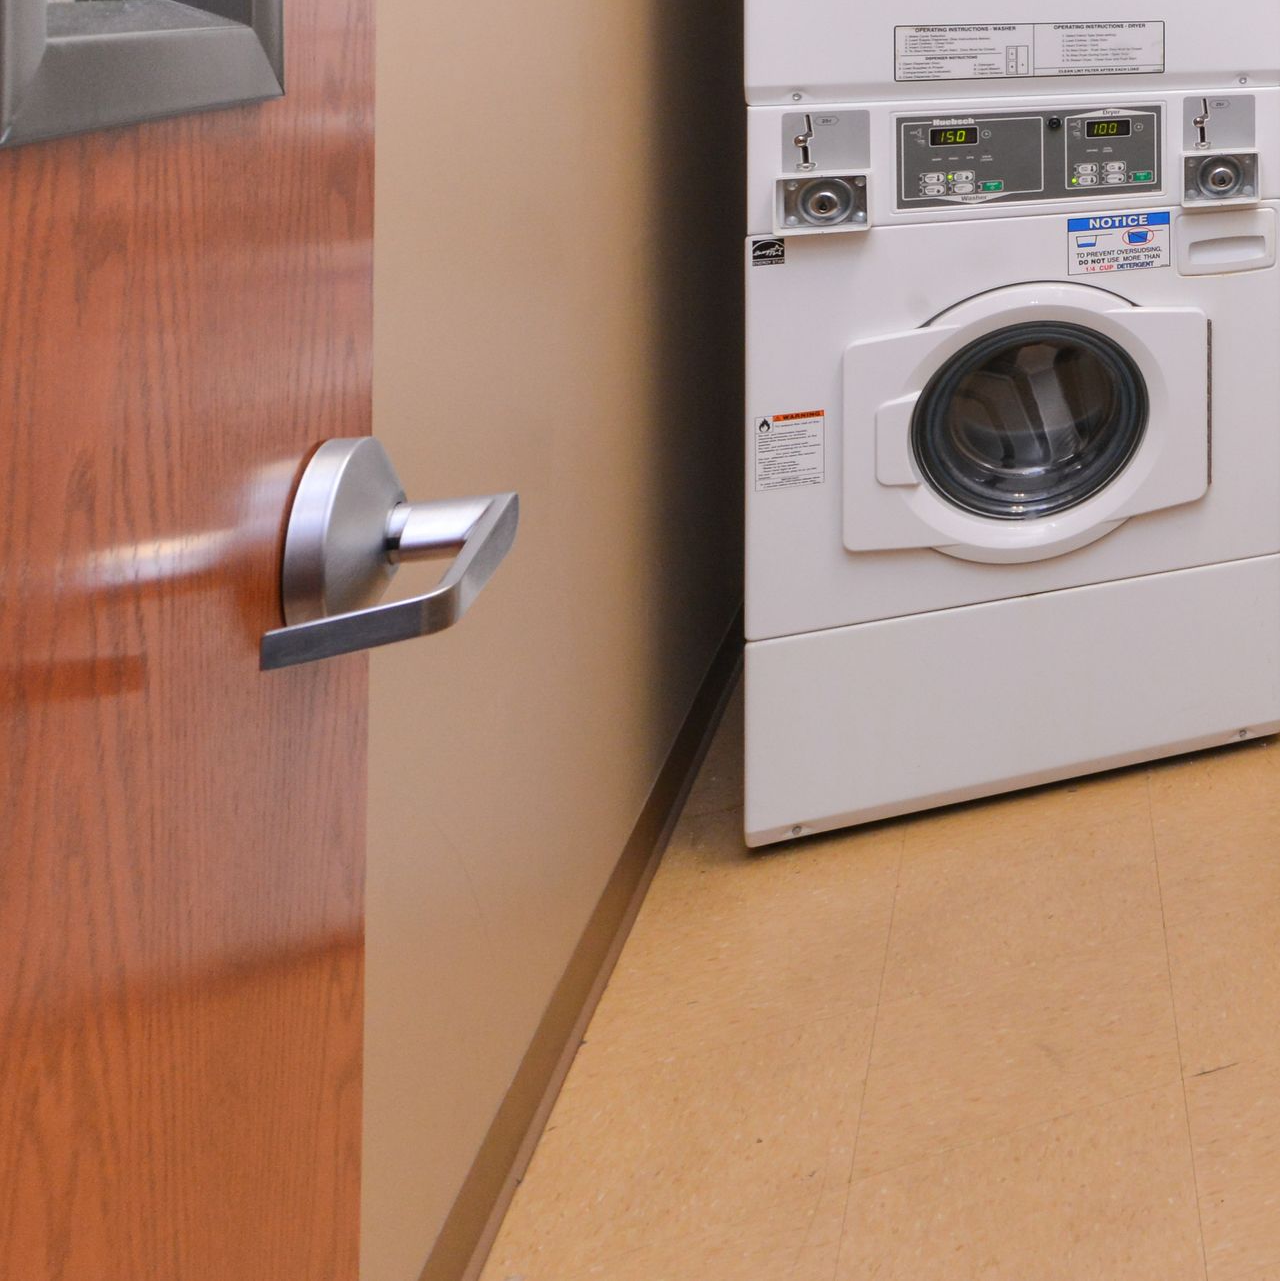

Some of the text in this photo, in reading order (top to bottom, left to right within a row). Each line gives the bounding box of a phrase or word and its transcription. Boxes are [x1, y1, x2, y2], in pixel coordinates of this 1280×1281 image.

[932, 118, 975, 126] Huebsch
[1094, 122, 1117, 135] 100
[940, 130, 966, 143] 150
[1089, 214, 1148, 229] NOTICE
[1086, 250, 1115, 258] PREVENT
[1117, 261, 1154, 269] DETERGENT
[783, 411, 820, 420] WARNING
